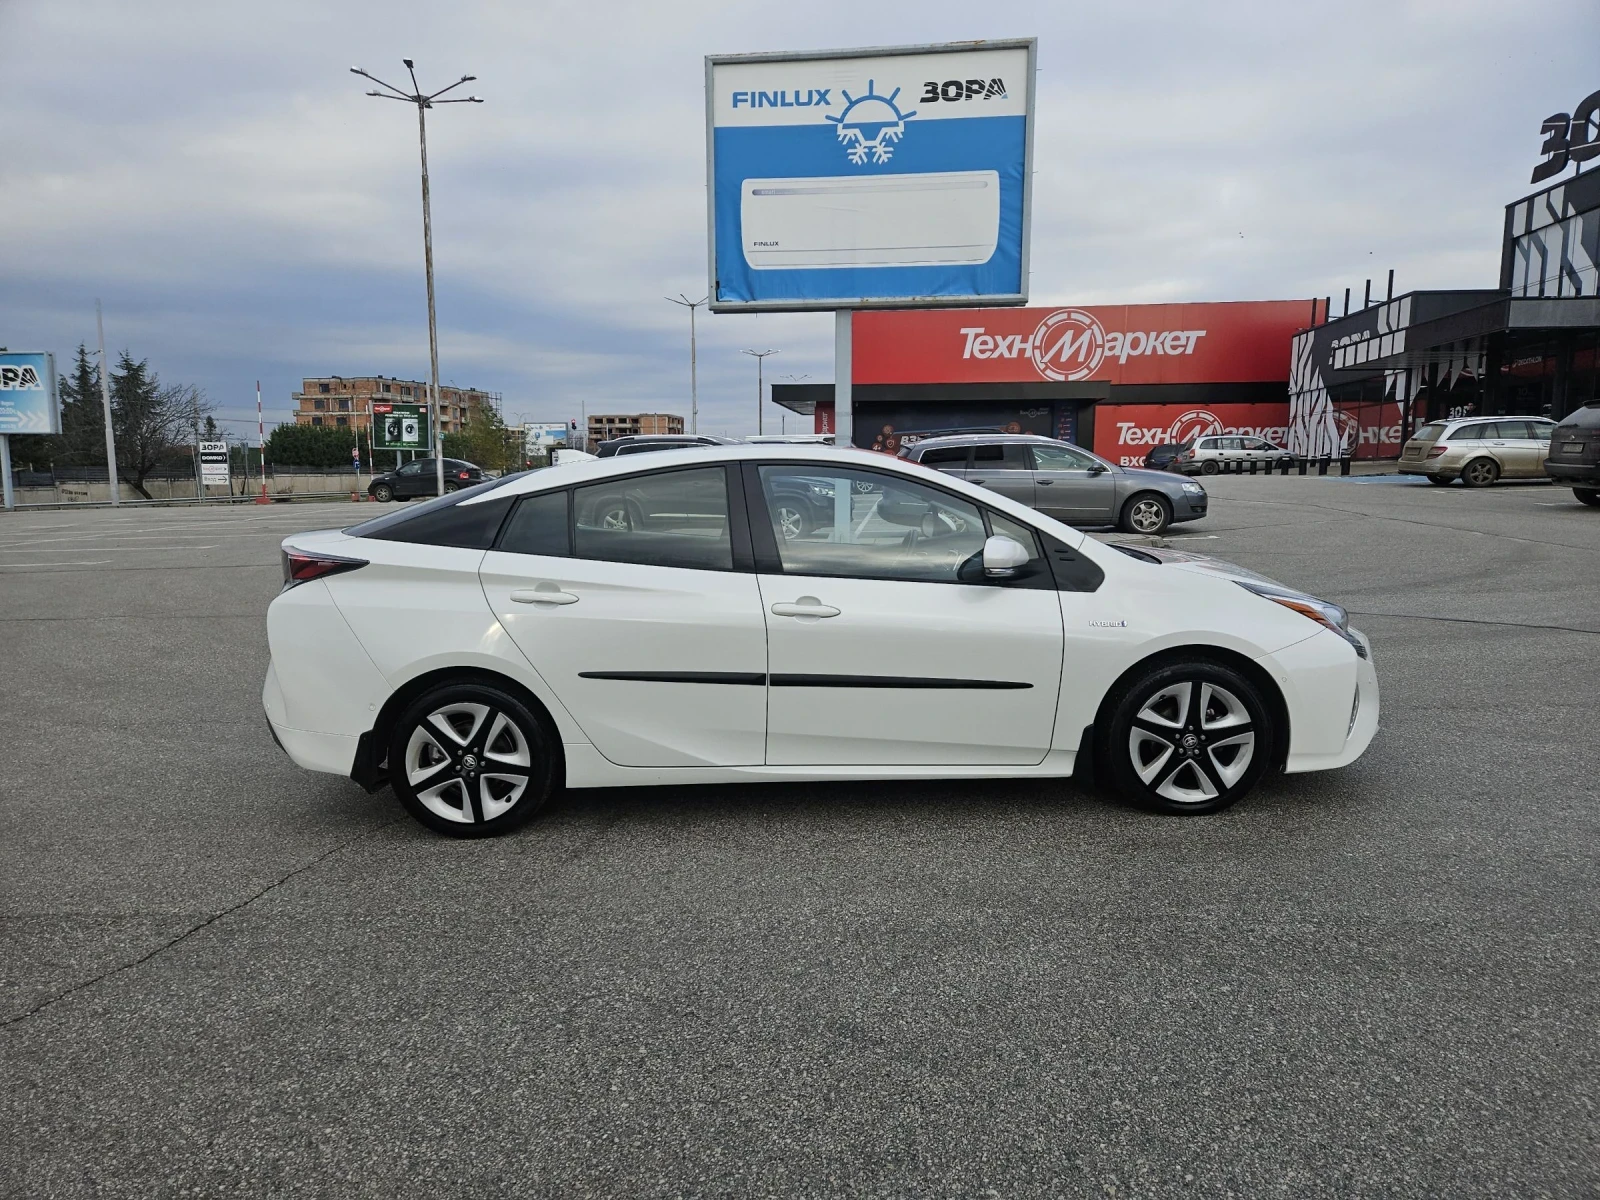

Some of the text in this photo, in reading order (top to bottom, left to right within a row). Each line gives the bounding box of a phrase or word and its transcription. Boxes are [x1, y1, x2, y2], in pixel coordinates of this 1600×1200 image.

[732, 89, 831, 109] FINLUX
[919, 78, 1008, 104] ЗОРА
[0, 366, 43, 389] РА
